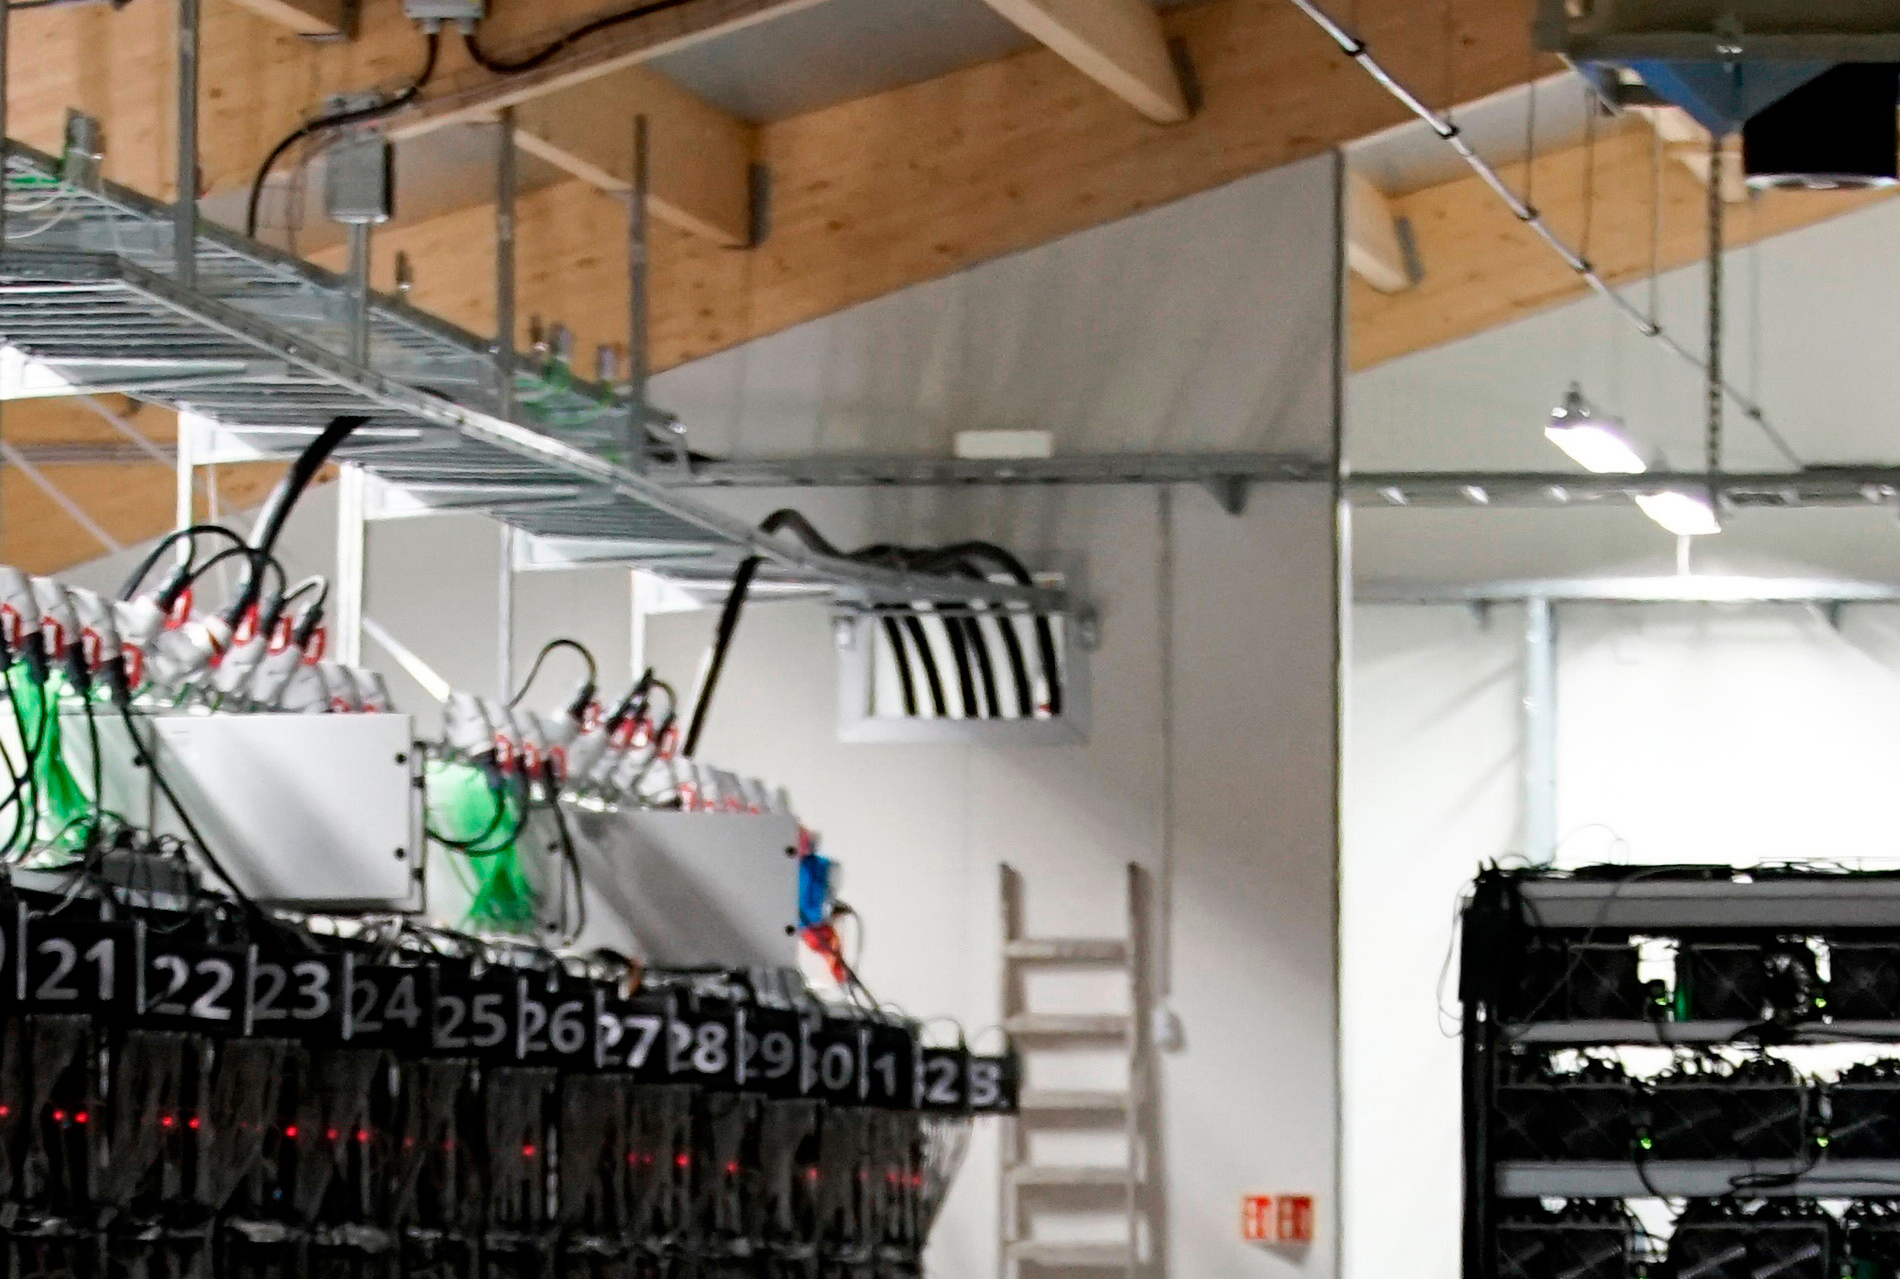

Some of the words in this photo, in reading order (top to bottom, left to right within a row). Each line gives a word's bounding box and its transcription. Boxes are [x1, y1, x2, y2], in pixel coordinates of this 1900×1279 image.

[36, 938, 115, 1000] 21
[151, 956, 234, 1020] 22
[251, 960, 330, 1020] 23
[351, 974, 422, 1032] 24
[433, 993, 508, 1048] 25
[523, 1001, 586, 1053] 26
[600, 1012, 663, 1068] 27
[671, 1021, 729, 1074] 28
[873, 1052, 897, 1098] 1
